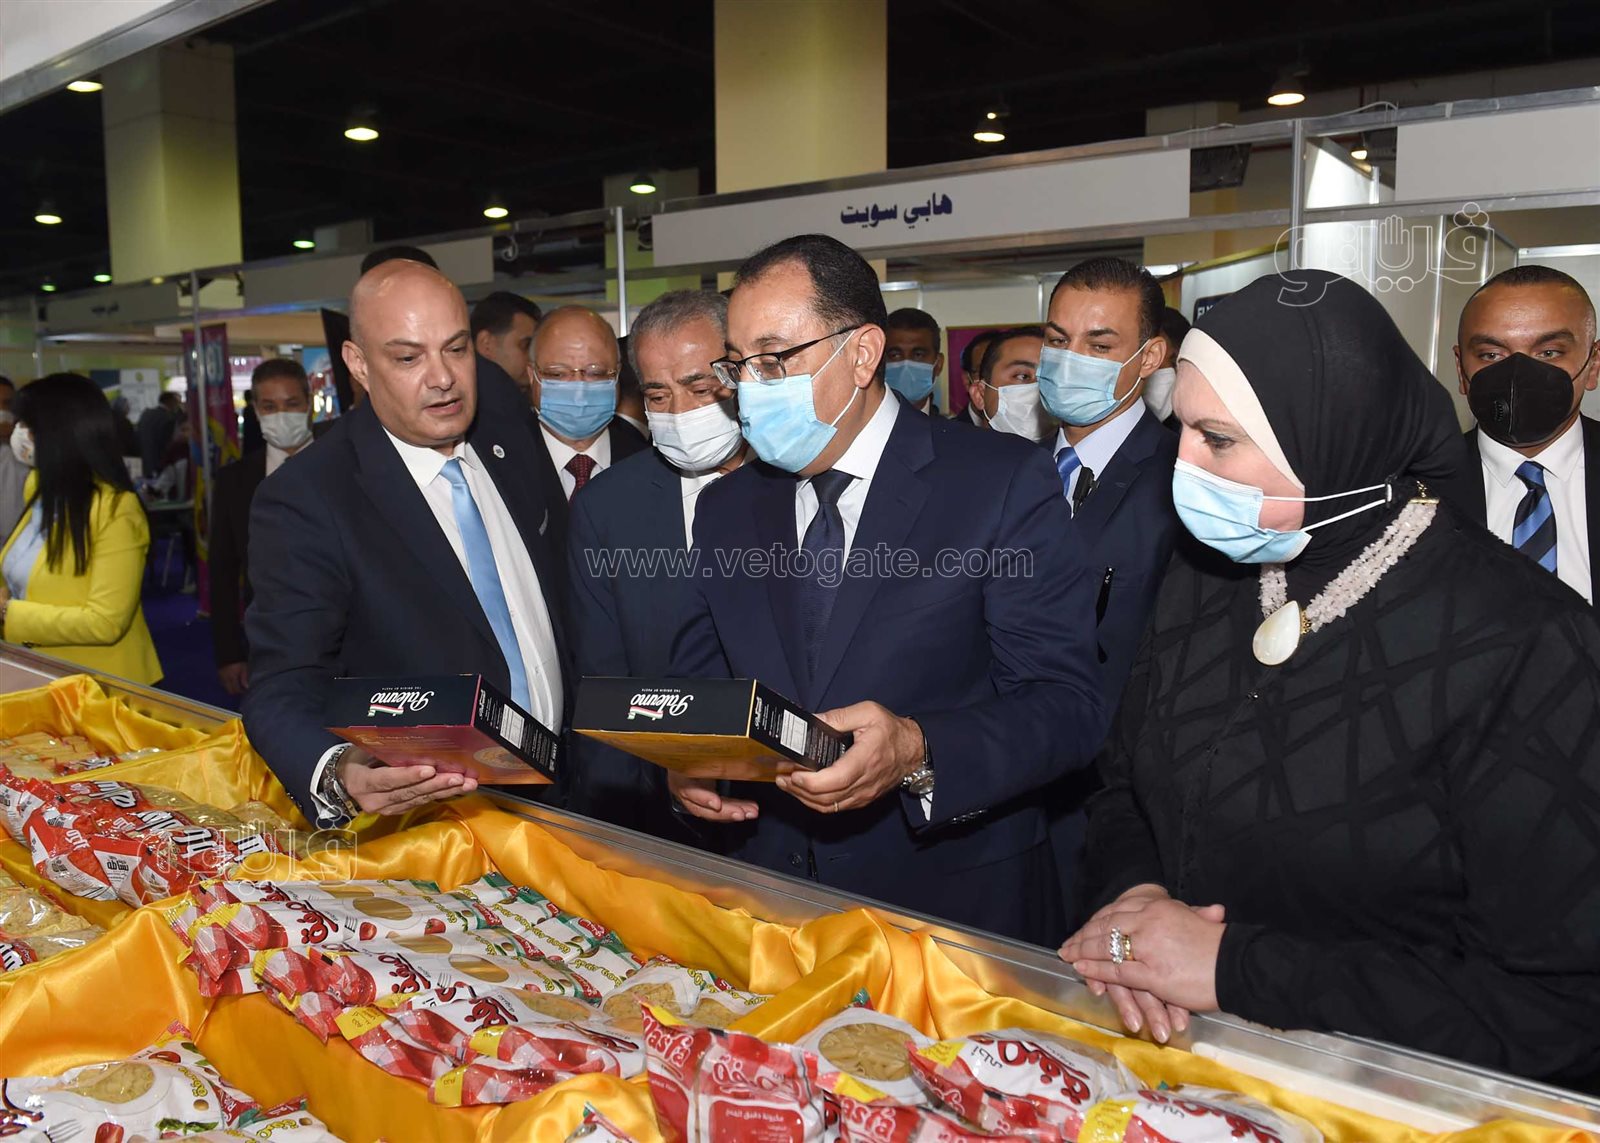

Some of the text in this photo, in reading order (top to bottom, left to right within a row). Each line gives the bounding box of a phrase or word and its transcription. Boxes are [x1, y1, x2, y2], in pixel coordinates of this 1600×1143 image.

[840, 192, 953, 229] هابي سويت
[370, 690, 435, 712] Palermo
[630, 693, 694, 716] Palermo
